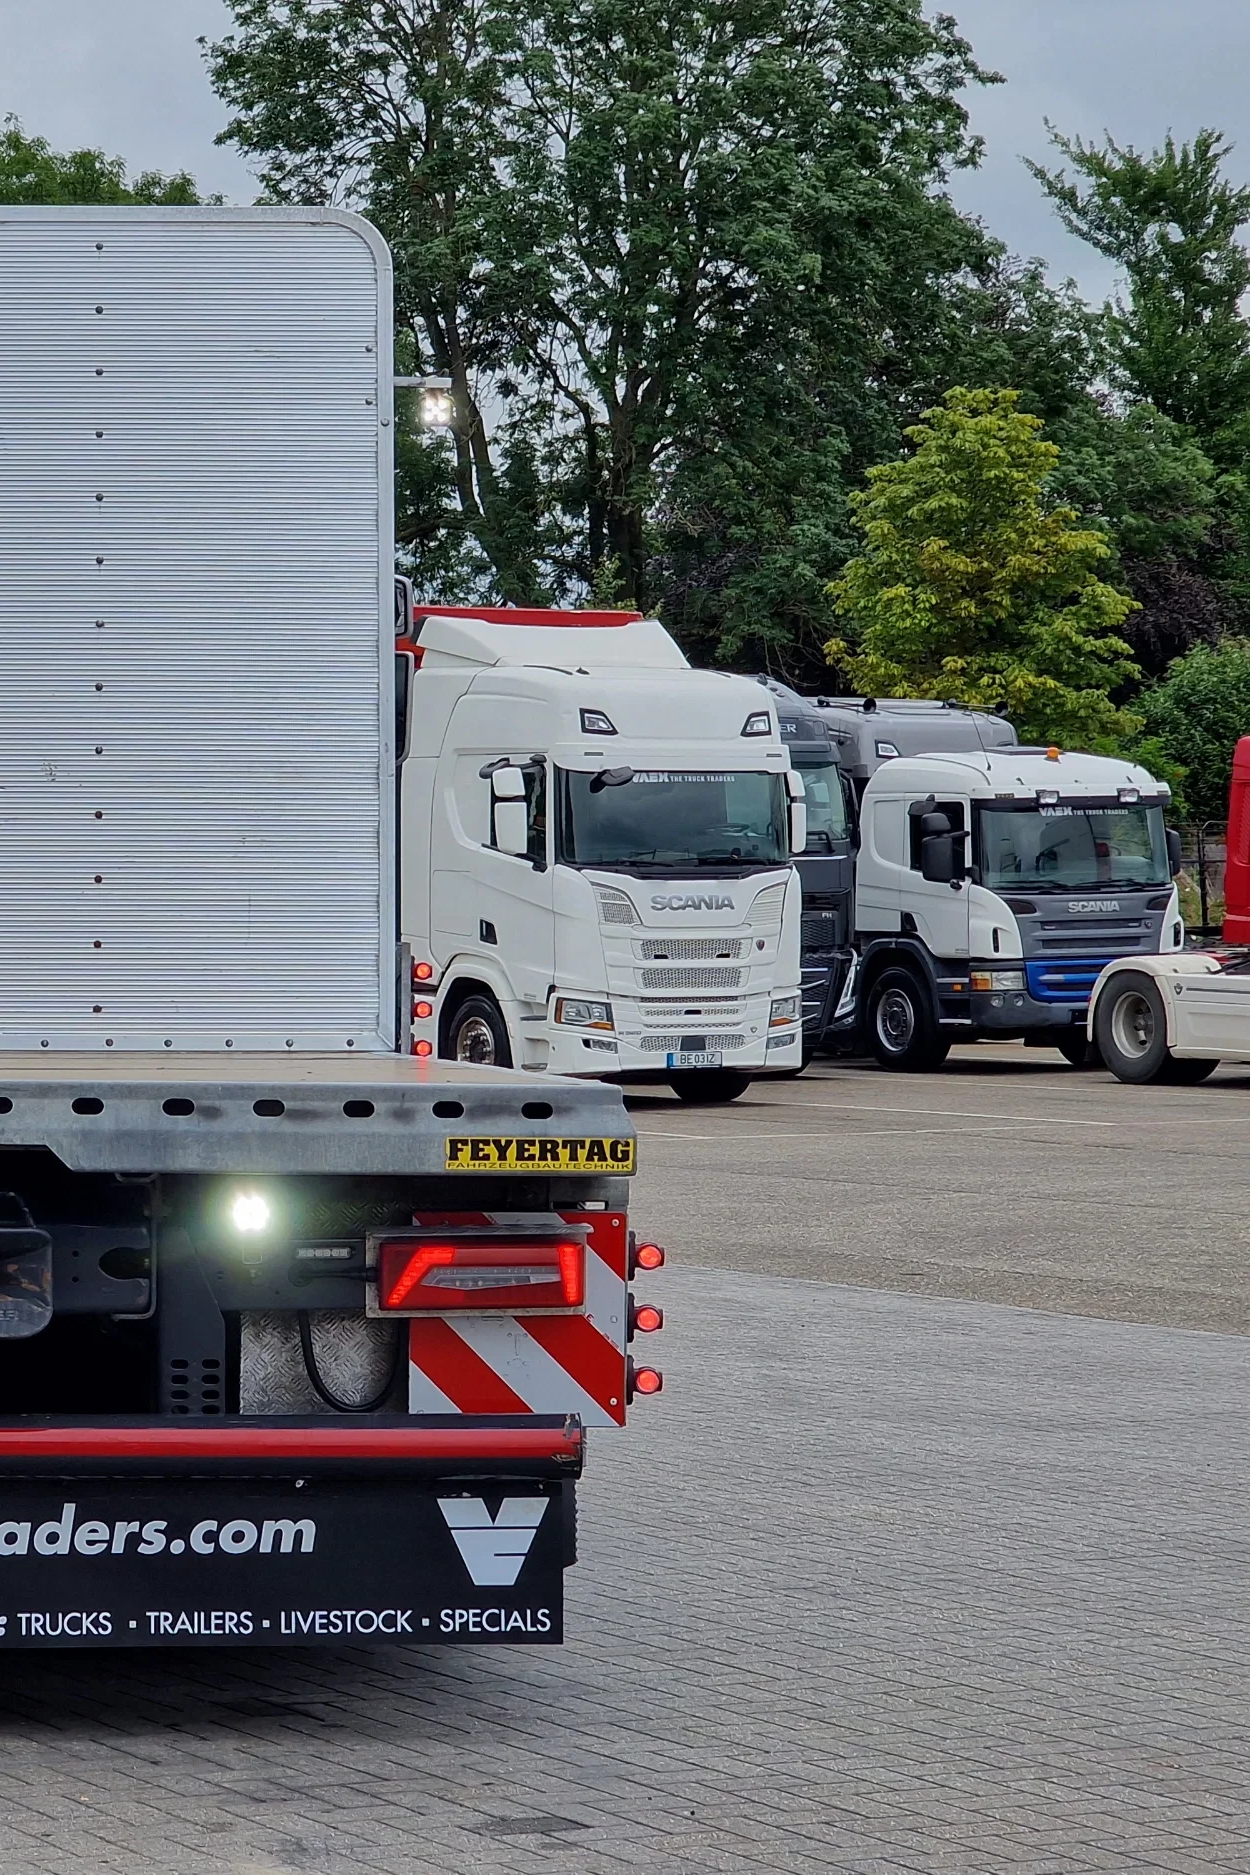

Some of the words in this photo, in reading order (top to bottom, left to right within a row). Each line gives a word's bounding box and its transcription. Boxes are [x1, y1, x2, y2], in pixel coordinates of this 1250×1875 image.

[650, 894, 736, 912] SCANIA
[1067, 901, 1120, 913] SCANIA
[448, 1138, 631, 1163] FEYERTAG
[447, 1161, 631, 1170] FAHRZEUGBAUTECHNIK
[18, 1612, 113, 1637] TRUCKS
[146, 1611, 253, 1636] TRAILERS
[279, 1609, 413, 1635] LIVESTOCK
[438, 1608, 552, 1633] SPECIALS
